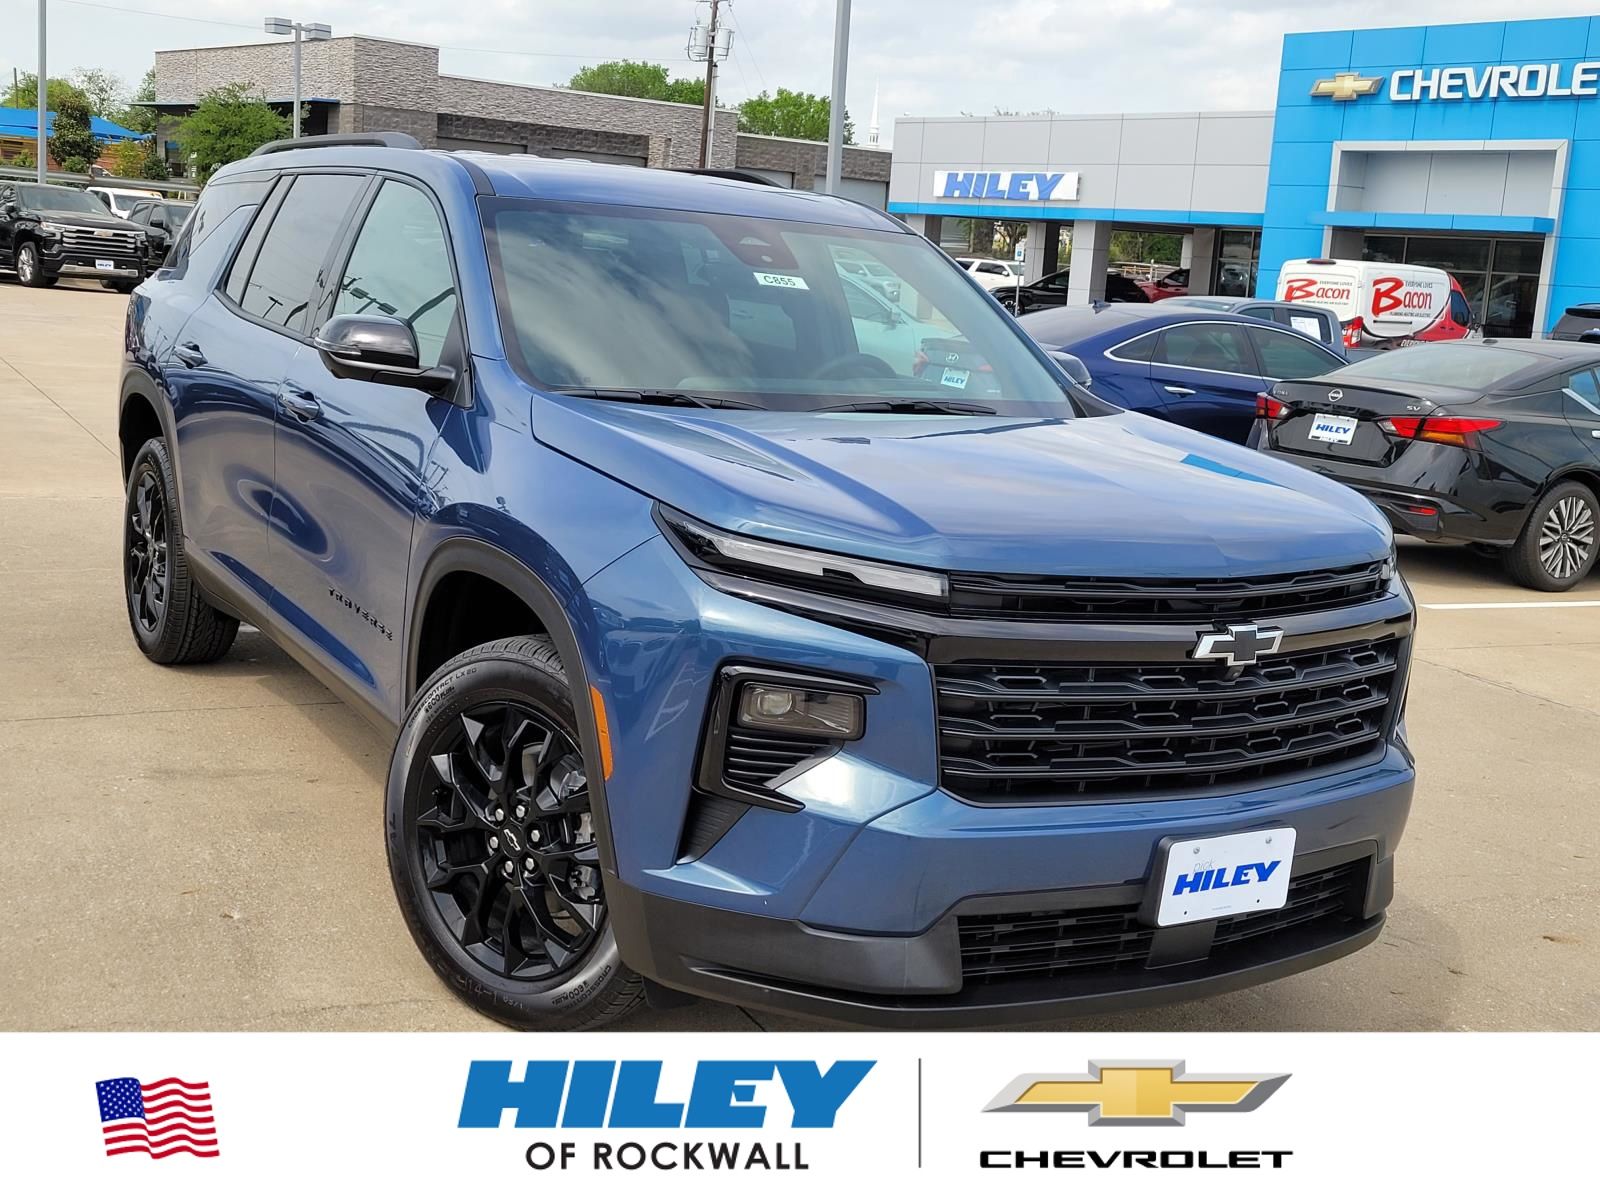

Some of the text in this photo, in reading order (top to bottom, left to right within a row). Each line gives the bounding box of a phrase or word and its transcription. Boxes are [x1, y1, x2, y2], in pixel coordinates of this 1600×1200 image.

[943, 172, 1065, 200] HILEY
[763, 274, 796, 287] C855
[1284, 278, 1350, 302] Bacon
[1372, 277, 1432, 317] Bacon
[944, 376, 965, 384] HILEY
[1315, 423, 1350, 434] HILEY
[1172, 860, 1281, 896] HILEY
